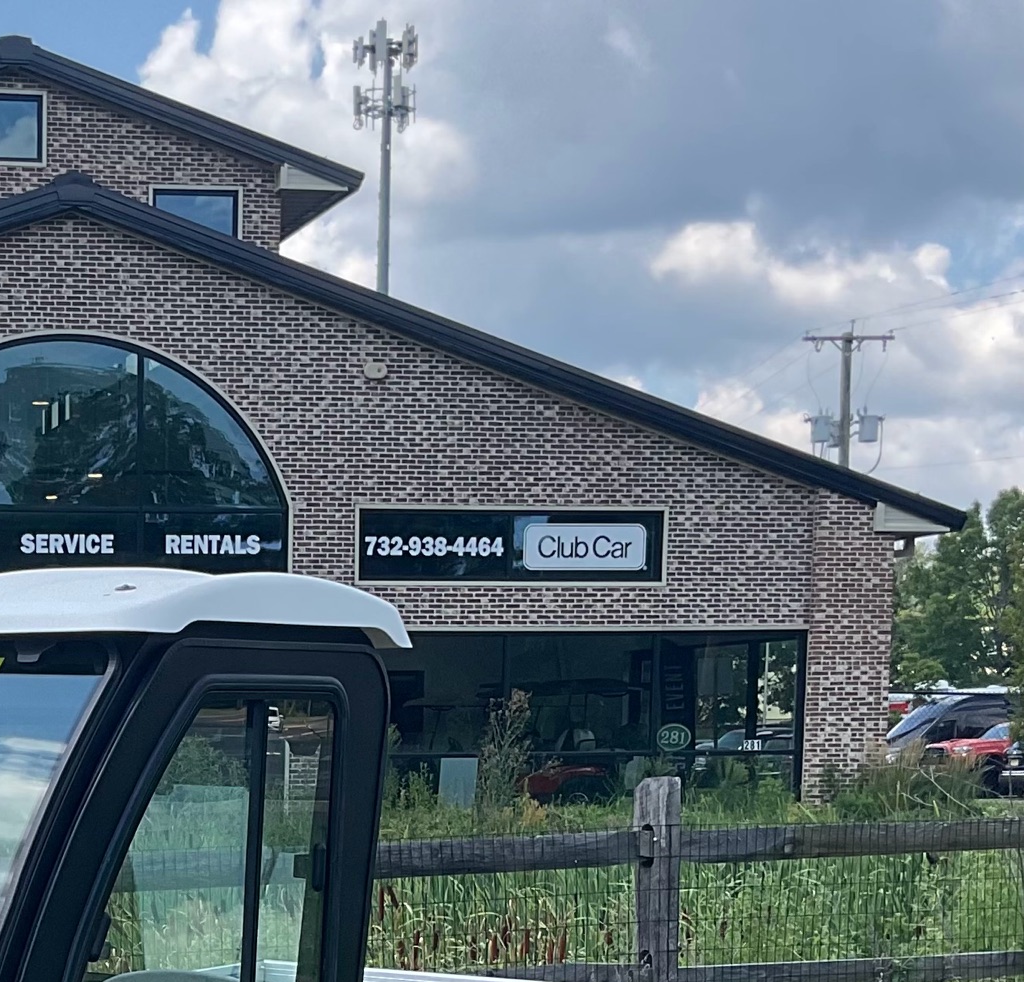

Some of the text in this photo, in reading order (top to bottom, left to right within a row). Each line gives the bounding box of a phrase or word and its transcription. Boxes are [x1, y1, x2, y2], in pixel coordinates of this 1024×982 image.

[20, 533, 115, 555] SERVICE
[165, 534, 261, 555] RENTALS
[364, 536, 504, 557] 732-938-4464
[537, 535, 632, 559] Club Car
[660, 730, 687, 745] 281
[744, 740, 761, 750] 281
